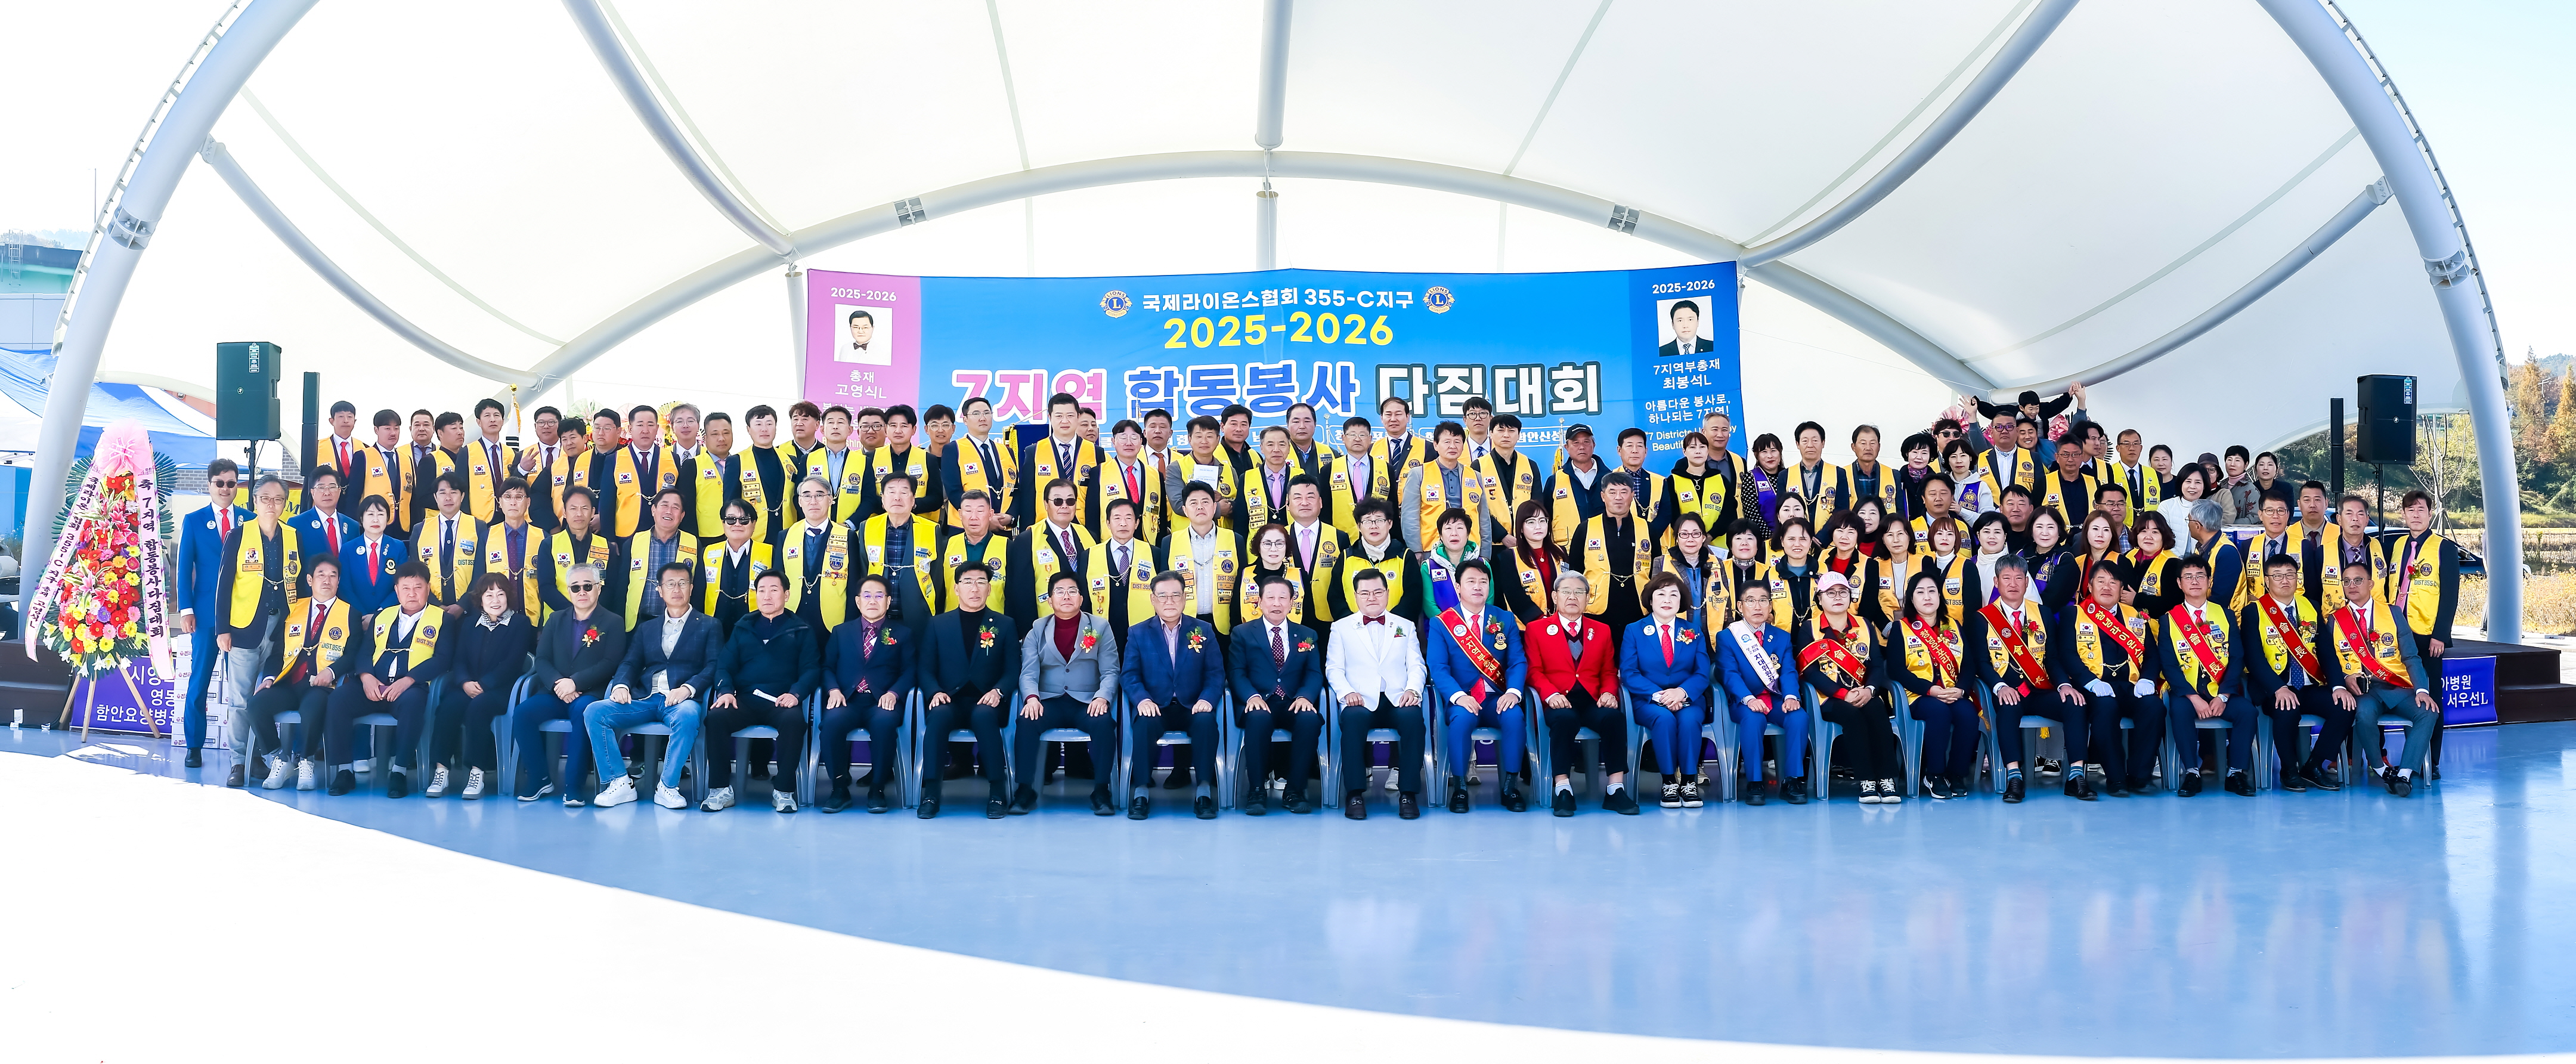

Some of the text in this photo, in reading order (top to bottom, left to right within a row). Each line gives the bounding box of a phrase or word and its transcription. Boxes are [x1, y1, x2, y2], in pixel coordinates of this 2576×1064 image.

[1652, 279, 1716, 294] 2025-2026
[831, 287, 897, 302] 2025-2026
[1143, 287, 1414, 312] 국제라이온스협회 355-C지구
[1435, 295, 1444, 305] L
[1112, 299, 1121, 309] L
[1164, 311, 1394, 349] 2025-2026
[1653, 358, 1720, 375] 7지역부총재
[849, 370, 875, 383] 총재
[1662, 374, 1712, 389] 최봉석L
[835, 383, 887, 399] 고영식L
[1126, 361, 1358, 422] 합동봉사
[1377, 362, 1600, 417] 다짐대회
[1645, 394, 1730, 412] 아름다운 봉사로,
[1648, 410, 1693, 424] 하나되는
[138, 479, 153, 490] 축
[68, 477, 99, 531] 국제라이온협회
[1822, 573, 1844, 584] LIONS
[2447, 691, 2488, 708] 서우선L
